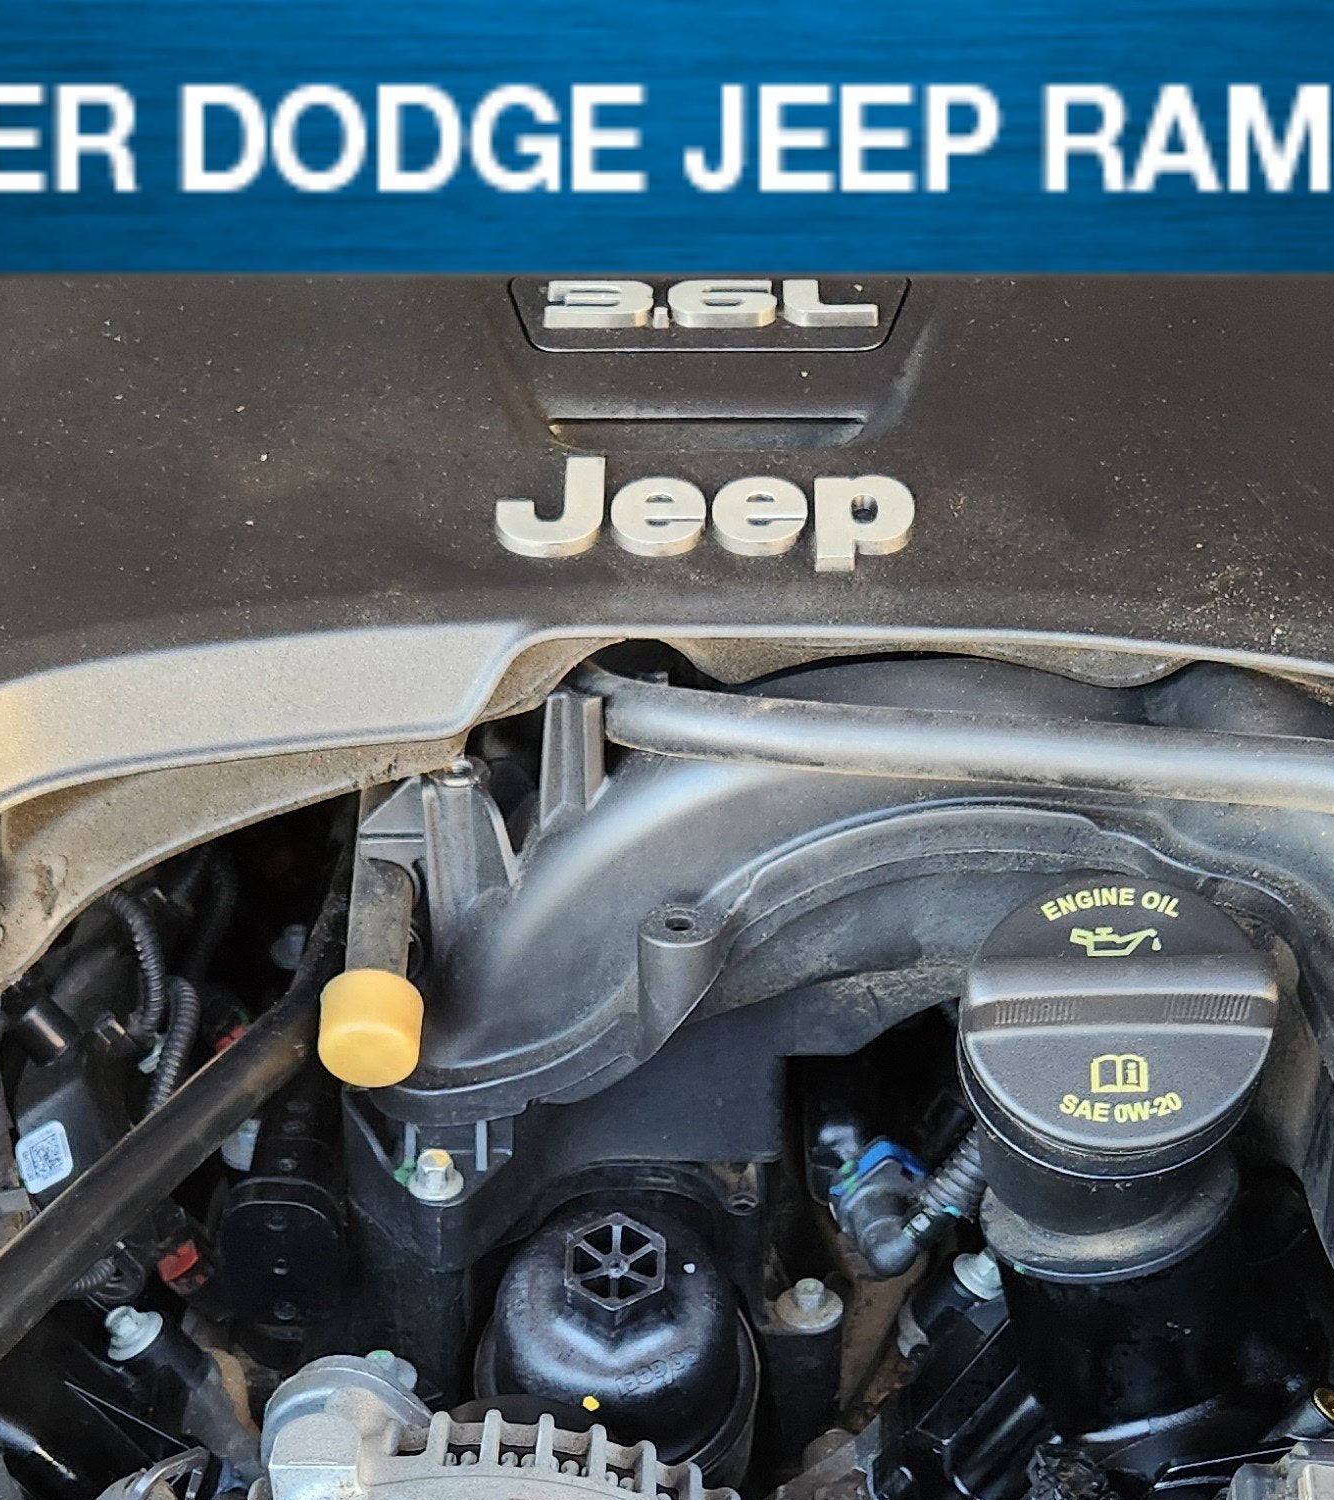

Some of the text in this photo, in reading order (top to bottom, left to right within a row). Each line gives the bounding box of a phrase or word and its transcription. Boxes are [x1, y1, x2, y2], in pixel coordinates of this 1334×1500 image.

[543, 279, 880, 329] 3.6L
[495, 455, 915, 572] Jeep
[1040, 886, 1181, 922] ENGINE OIL
[1059, 1092, 1183, 1124] SAE 0W-20
